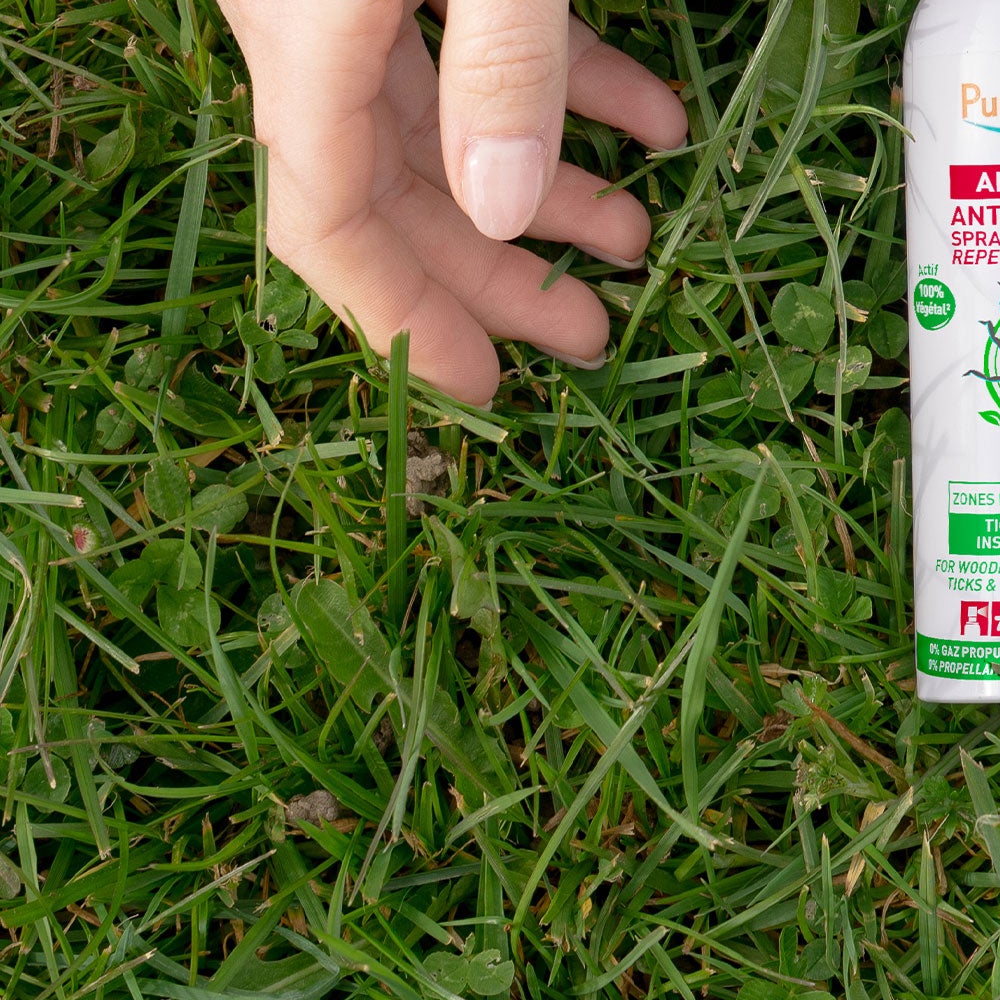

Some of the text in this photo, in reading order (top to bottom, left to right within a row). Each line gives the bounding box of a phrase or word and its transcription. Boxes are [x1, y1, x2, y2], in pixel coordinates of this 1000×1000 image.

[918, 264, 938, 276] Actif
[919, 284, 944, 298] 100%
[953, 492, 995, 505] ZONES
[935, 559, 955, 573] FOR
[948, 577, 982, 591] TICKS
[985, 578, 996, 592] &
[929, 642, 940, 656] 0%
[941, 644, 960, 657] GAZ
[928, 658, 938, 672] 0%
